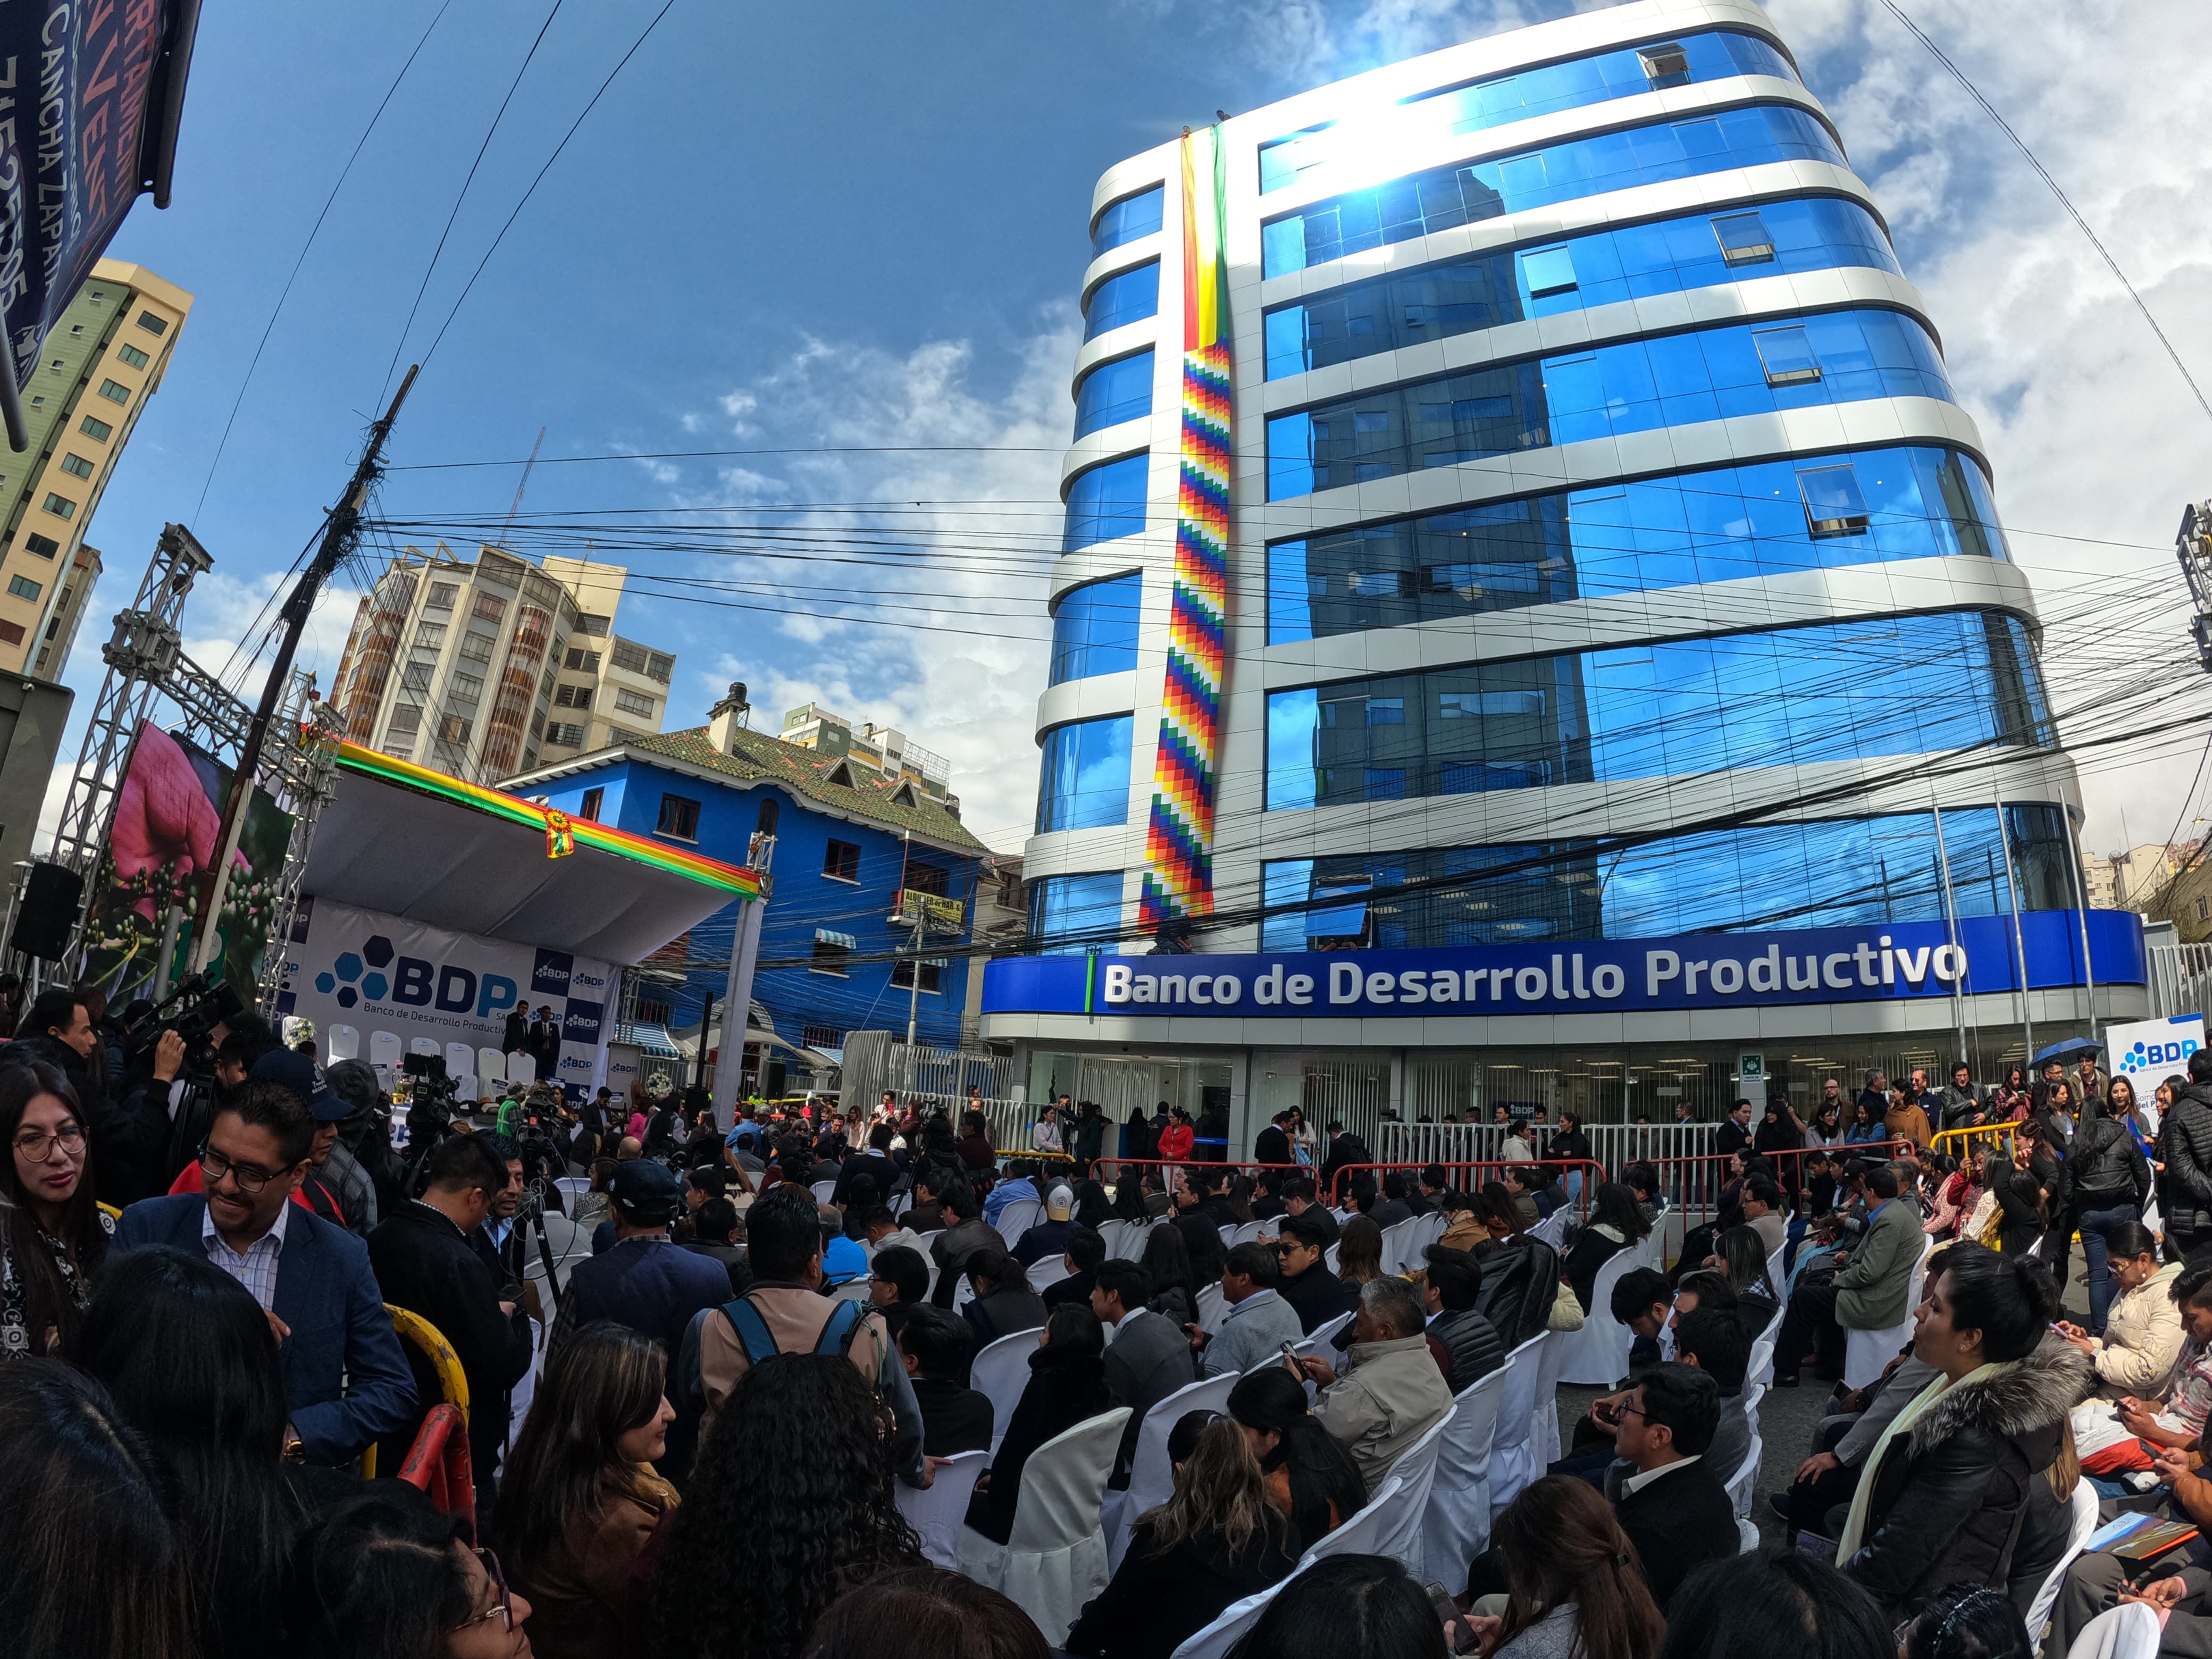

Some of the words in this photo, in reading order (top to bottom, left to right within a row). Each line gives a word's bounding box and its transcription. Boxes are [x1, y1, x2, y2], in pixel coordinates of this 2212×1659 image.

[38, 3, 70, 174] CANCHA
[38, 169, 68, 299] ZAPATA
[906, 891, 934, 905] ALQUER
[548, 968, 569, 979] BDP
[584, 976, 605, 987] BDP
[1104, 965, 1242, 1005] Banco
[1254, 965, 1313, 1004] de
[1330, 954, 1624, 1003] Desarrollo
[1646, 935, 1967, 996] Productivo
[392, 956, 517, 1018] BDP
[364, 1002, 393, 1017] Banco
[397, 1009, 409, 1018] de
[411, 1011, 460, 1027] Desarrollo
[463, 1020, 507, 1034] Productiv
[577, 1017, 599, 1028] BDP
[571, 1059, 592, 1068] BDP
[2147, 1039, 2198, 1065] BDP
